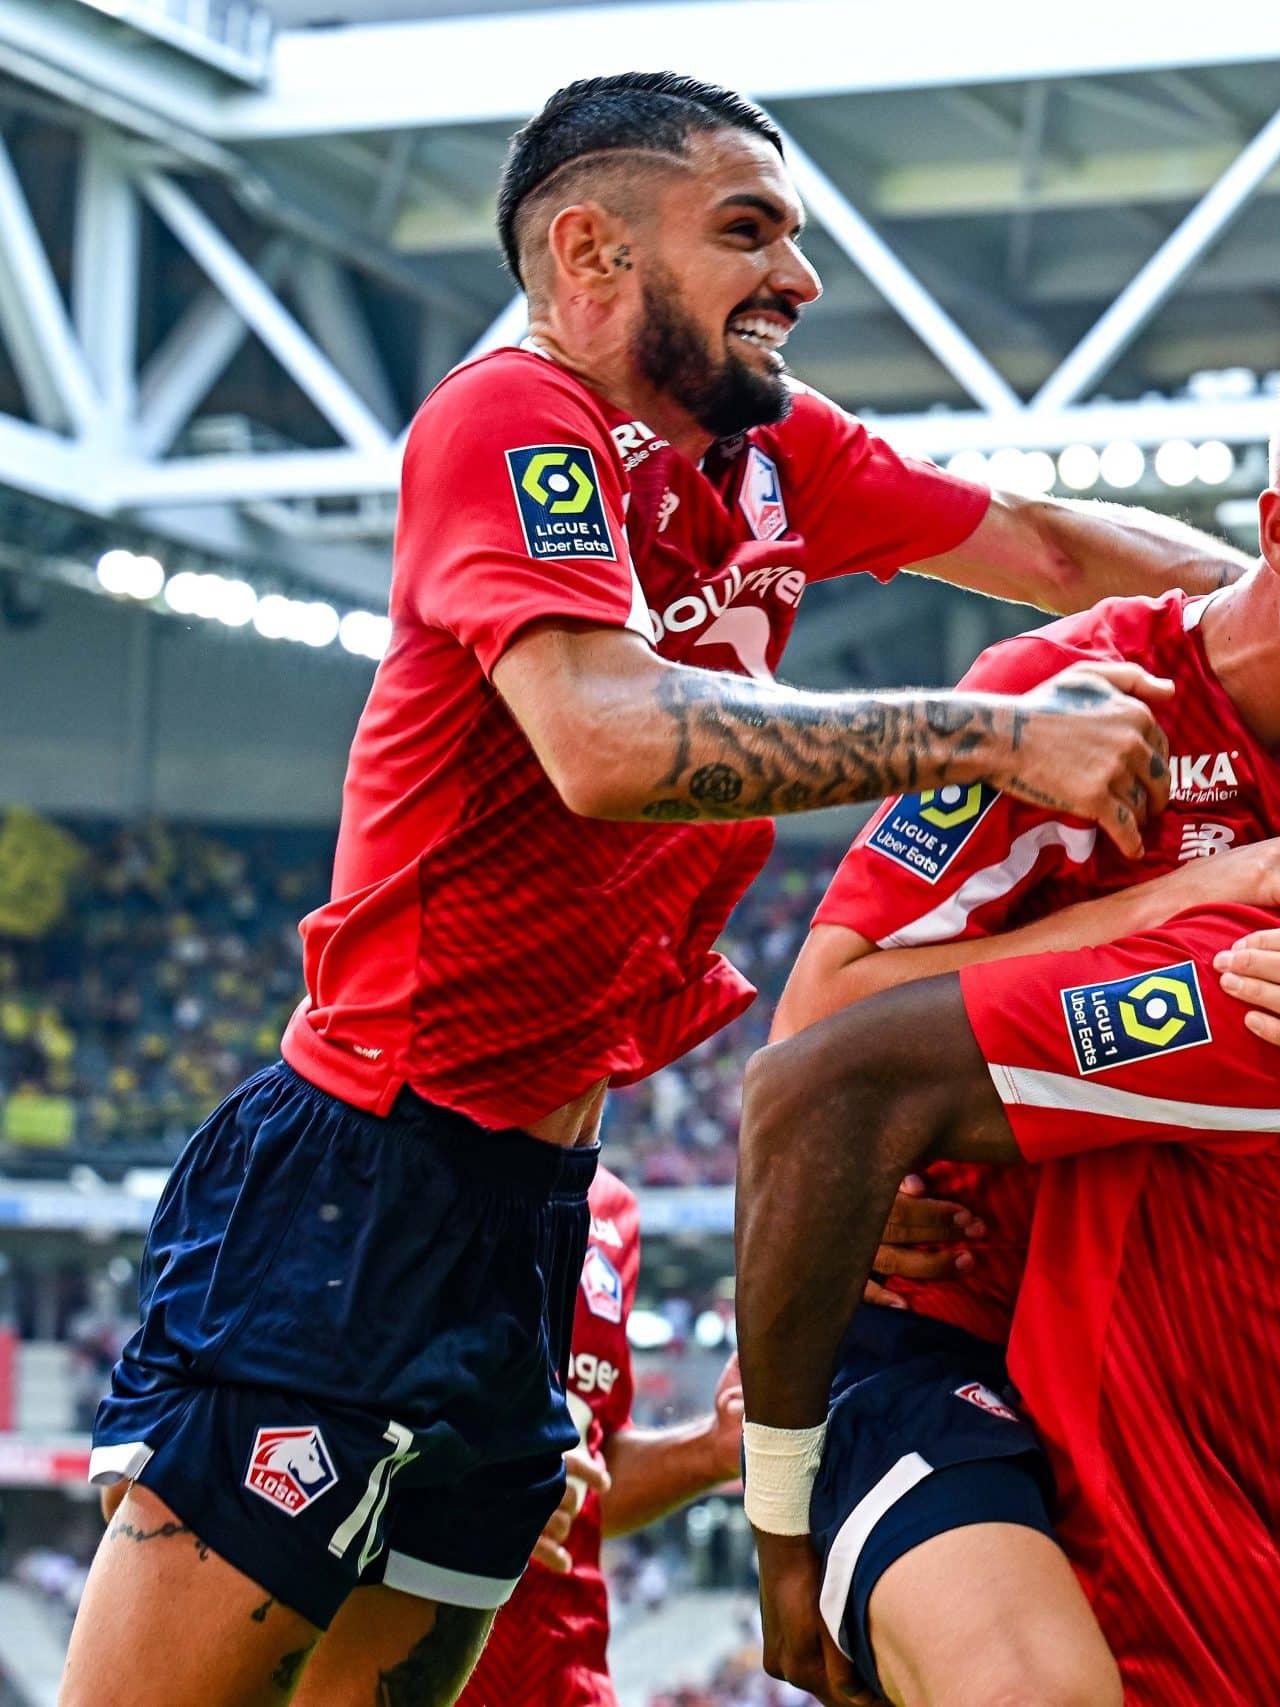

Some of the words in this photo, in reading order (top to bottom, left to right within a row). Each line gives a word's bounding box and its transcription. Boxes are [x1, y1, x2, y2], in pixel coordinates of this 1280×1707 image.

[609, 421, 657, 459] RI
[534, 540, 572, 554] Uber
[573, 538, 609, 553] Eats
[536, 522, 590, 537] LIGUE
[592, 523, 601, 536] 1
[876, 829, 908, 855] Uber
[905, 846, 938, 874] Eats
[892, 816, 939, 850] LIGUE
[938, 843, 949, 857] 1
[1070, 991, 1087, 1025] Uber
[1091, 990, 1116, 1044] LIGUE
[1105, 1046, 1118, 1056] 1
[1078, 1027, 1097, 1066] Eats
[254, 1471, 300, 1508] LOSC
